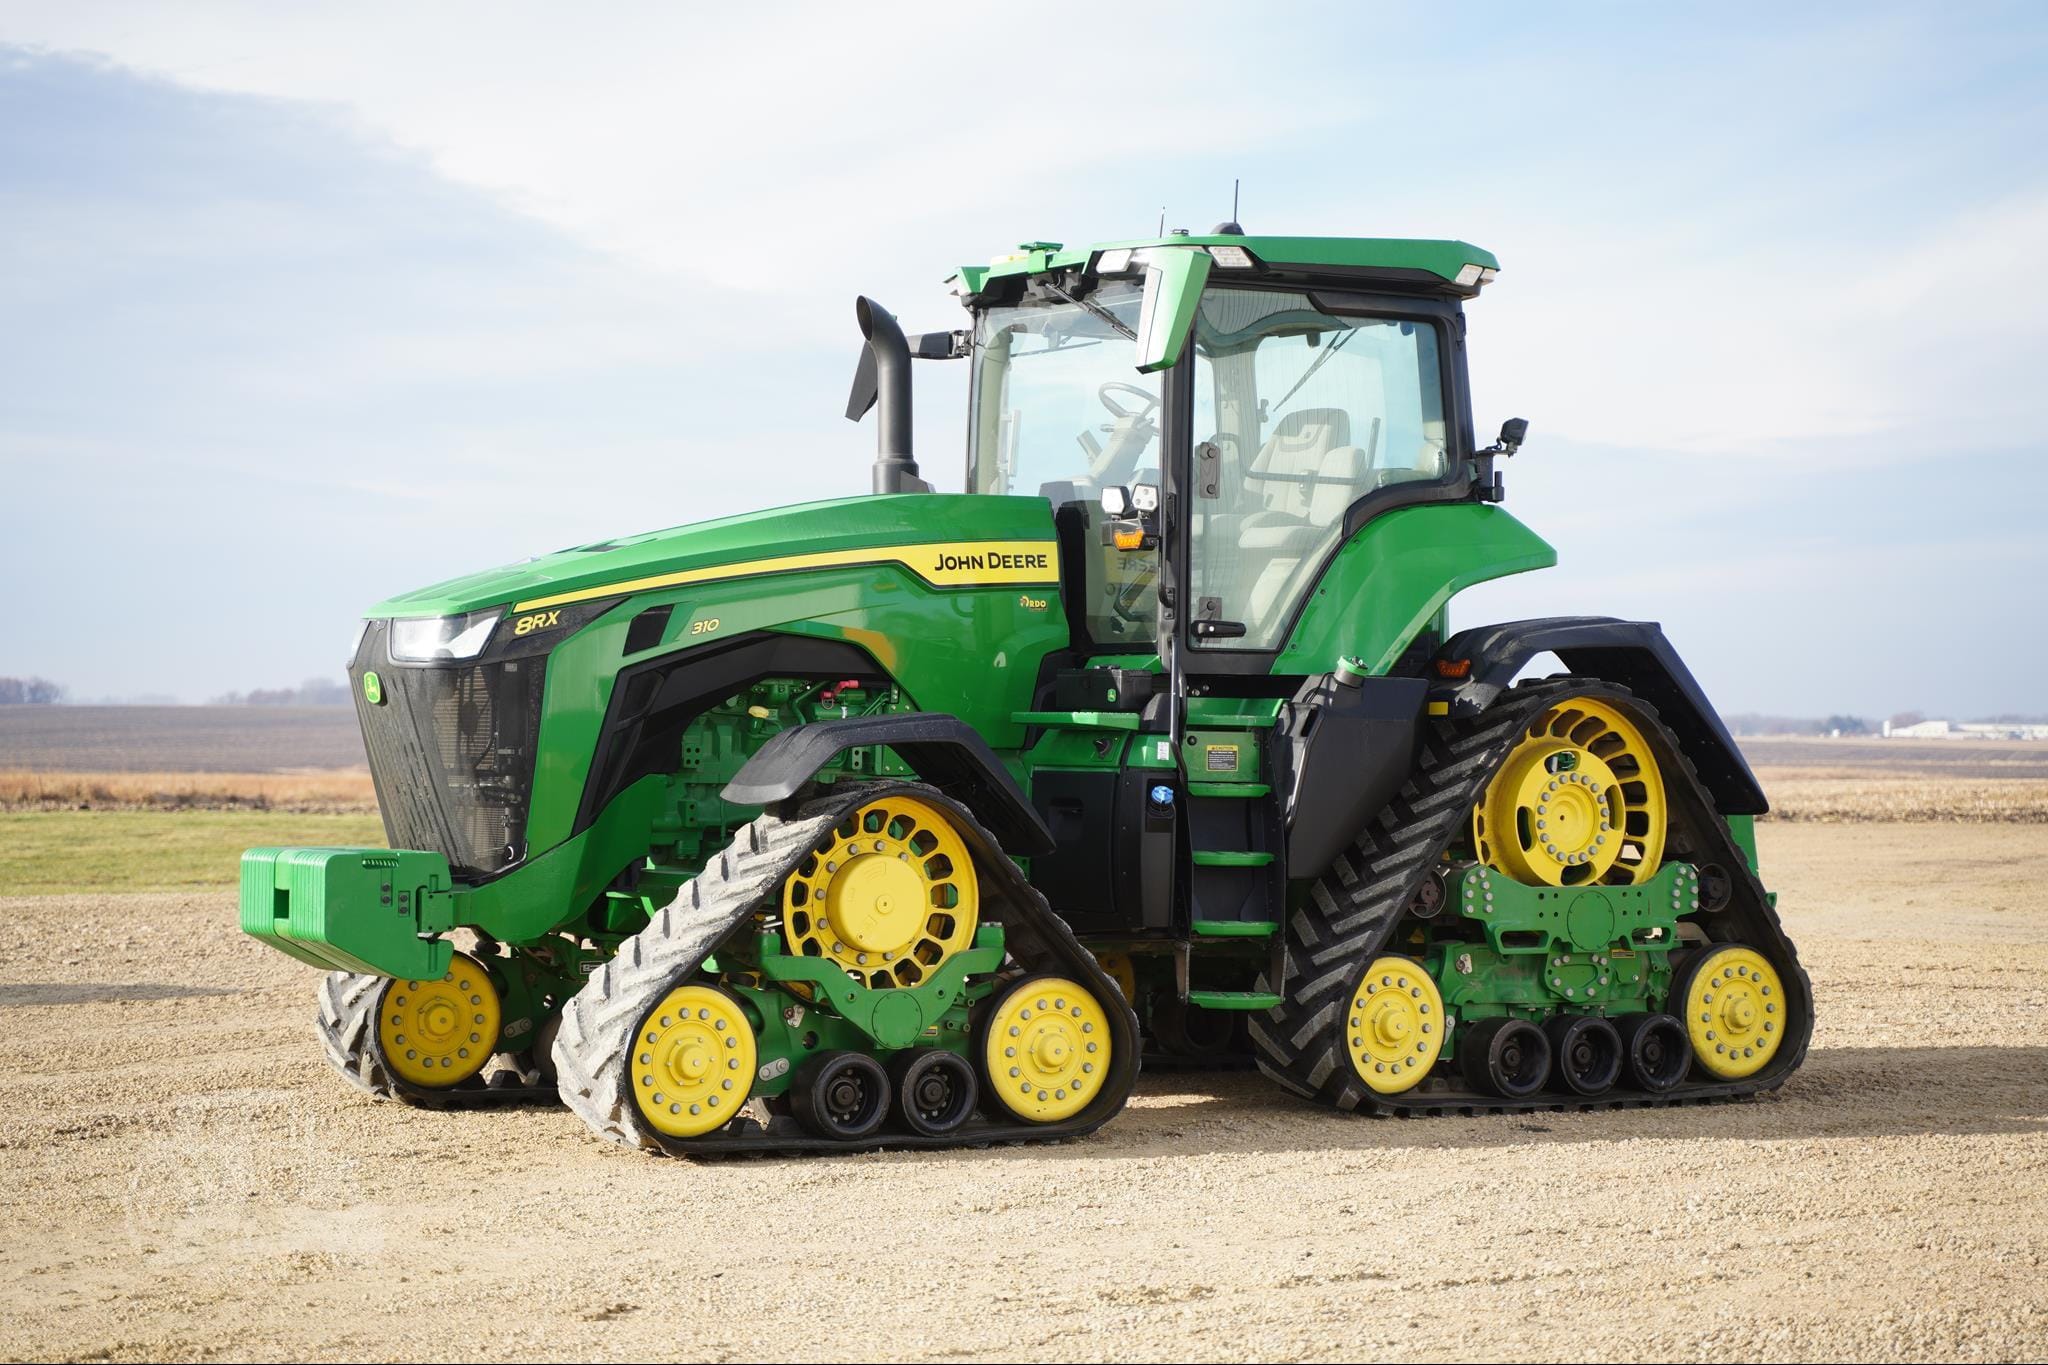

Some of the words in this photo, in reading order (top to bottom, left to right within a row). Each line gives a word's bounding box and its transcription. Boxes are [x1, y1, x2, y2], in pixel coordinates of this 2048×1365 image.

[934, 553, 984, 571] JOHN
[987, 552, 1048, 569] DEERE
[514, 610, 561, 635] 8RX
[691, 618, 720, 635] 310
